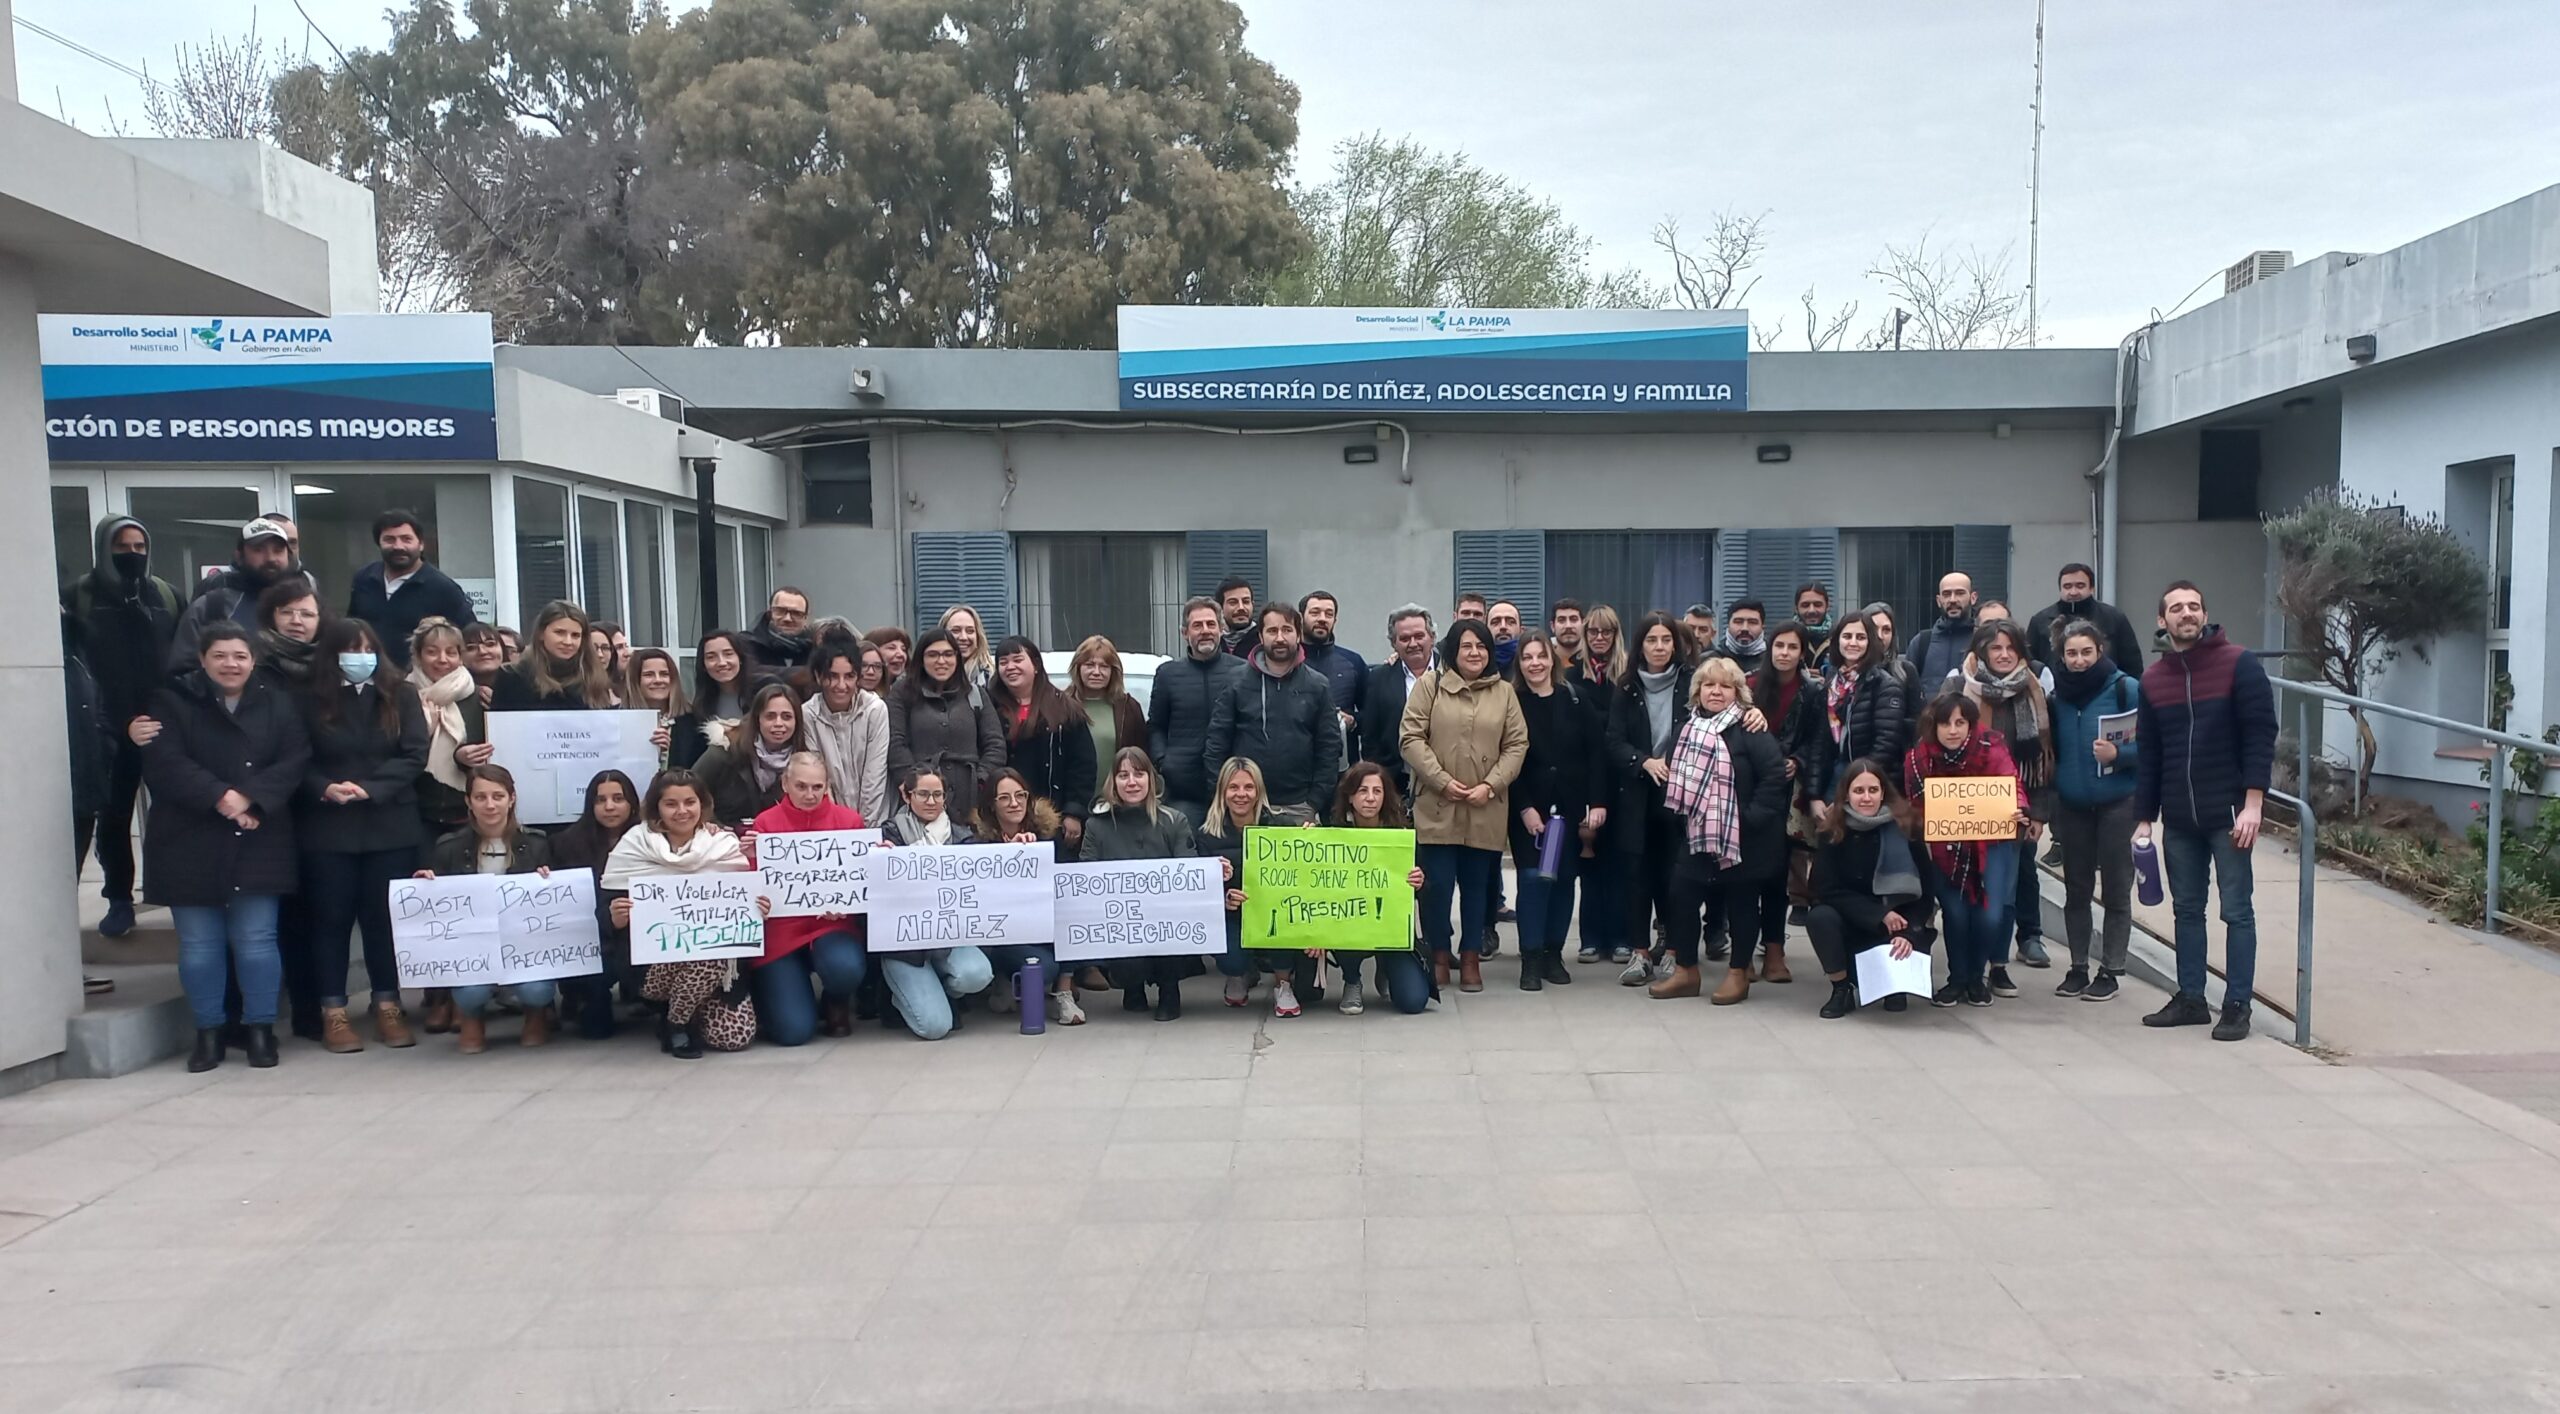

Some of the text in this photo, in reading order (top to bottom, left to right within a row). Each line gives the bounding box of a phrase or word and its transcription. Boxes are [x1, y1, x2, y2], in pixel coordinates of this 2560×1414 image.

[1355, 315, 1419, 323] Desarrollo Social
[1449, 316, 1512, 327] LA PAMPA
[72, 326, 178, 338] Desarrollo Social
[229, 328, 333, 343] LA PAMPA
[130, 344, 179, 352] MINISTERIO
[241, 344, 280, 353] Gobierno
[294, 344, 322, 353] Acción
[1133, 379, 1316, 400] SUBSECRETARÍA
[1322, 384, 1352, 400] DE
[1358, 380, 1432, 403] NIÑEZ,
[1437, 383, 1607, 401] ADOLESCENCIA
[1634, 384, 1732, 401] FAMILIA
[125, 419, 163, 438] DE
[170, 418, 313, 438] PERSONAS
[319, 417, 456, 440] MAYORES
[546, 731, 592, 740] FAMILIAS
[1958, 804, 1976, 815] DE
[1926, 819, 2016, 836] DISCAPACIDAD
[763, 836, 847, 867] BASTA
[1258, 836, 1369, 864] DISPOSITIVO
[887, 849, 1039, 882] DIRECCIÓN
[1053, 863, 1206, 899] PROTECCIÓN
[1260, 866, 1389, 889] ROQUE SAENZ PEÑA
[496, 880, 578, 915] BASTA
[633, 879, 749, 903] DIR. VIOLENCIA
[784, 883, 869, 909] LABORAL
[937, 885, 979, 910] DE
[394, 886, 475, 921] BASTA
[670, 904, 753, 925] FAMILIAR
[1104, 900, 1144, 921] DE
[424, 918, 464, 941] DE
[522, 912, 563, 934] DE
[896, 909, 1009, 943] NIÑEZ
[1068, 921, 1207, 945] DERECHOS
[646, 920, 763, 953] PRESENTE
